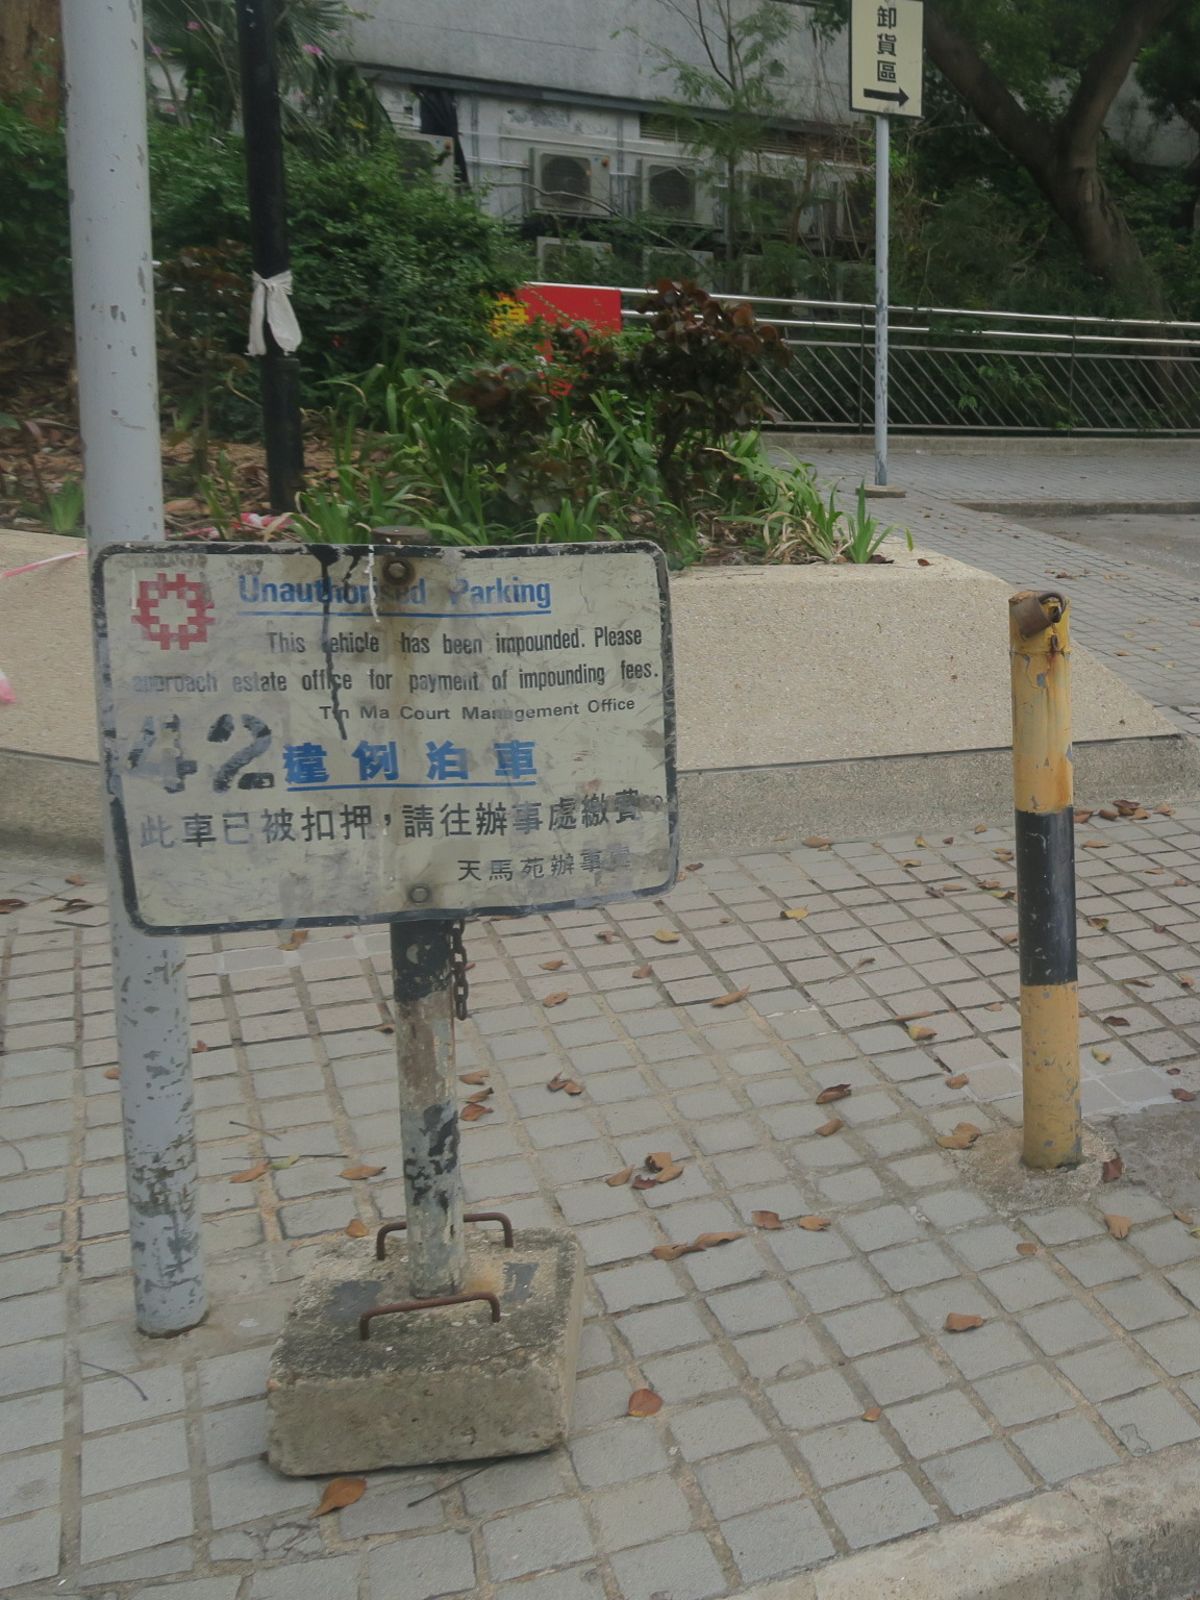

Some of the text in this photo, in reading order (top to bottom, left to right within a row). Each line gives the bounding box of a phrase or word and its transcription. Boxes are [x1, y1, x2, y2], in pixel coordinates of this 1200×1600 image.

[877, 5, 897, 83] 卸貨區
[452, 576, 551, 609] Parking
[266, 626, 642, 655] This ehicle has been impounded. Please
[232, 672, 287, 693] estate
[369, 668, 393, 690] for
[409, 671, 479, 693] payment
[492, 669, 507, 691] of
[519, 663, 605, 690] impounding
[621, 660, 658, 680] fees.
[319, 698, 635, 722] Tn Ma Court Management Office
[128, 713, 274, 794] 42
[283, 739, 537, 784] 違例泊車
